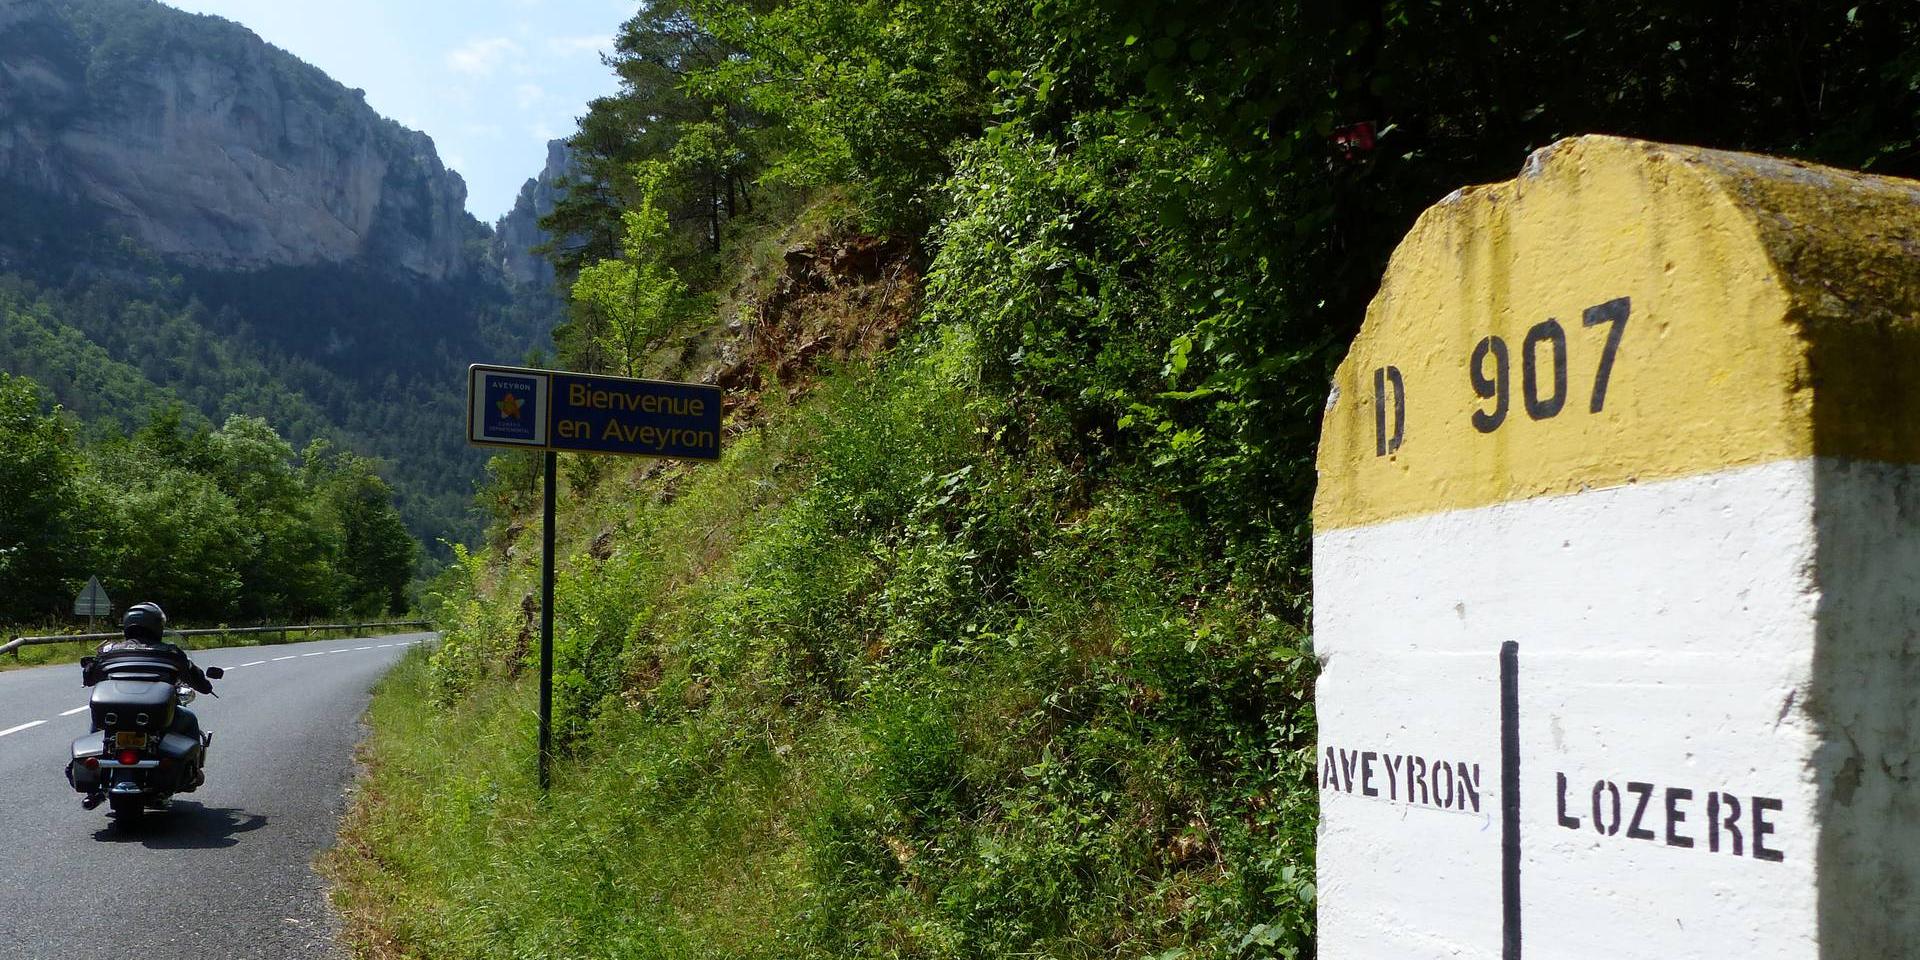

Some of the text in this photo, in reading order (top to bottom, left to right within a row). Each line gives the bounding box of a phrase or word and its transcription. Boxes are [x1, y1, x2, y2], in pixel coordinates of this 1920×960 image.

[492, 381, 531, 391] AVEYRON
[568, 383, 705, 416] Bienvenue
[1373, 296, 1631, 457] D 907
[557, 418, 714, 450] en Aveyron
[1321, 746, 1480, 812] AVEYRON
[1556, 771, 1785, 863] LOZERE
